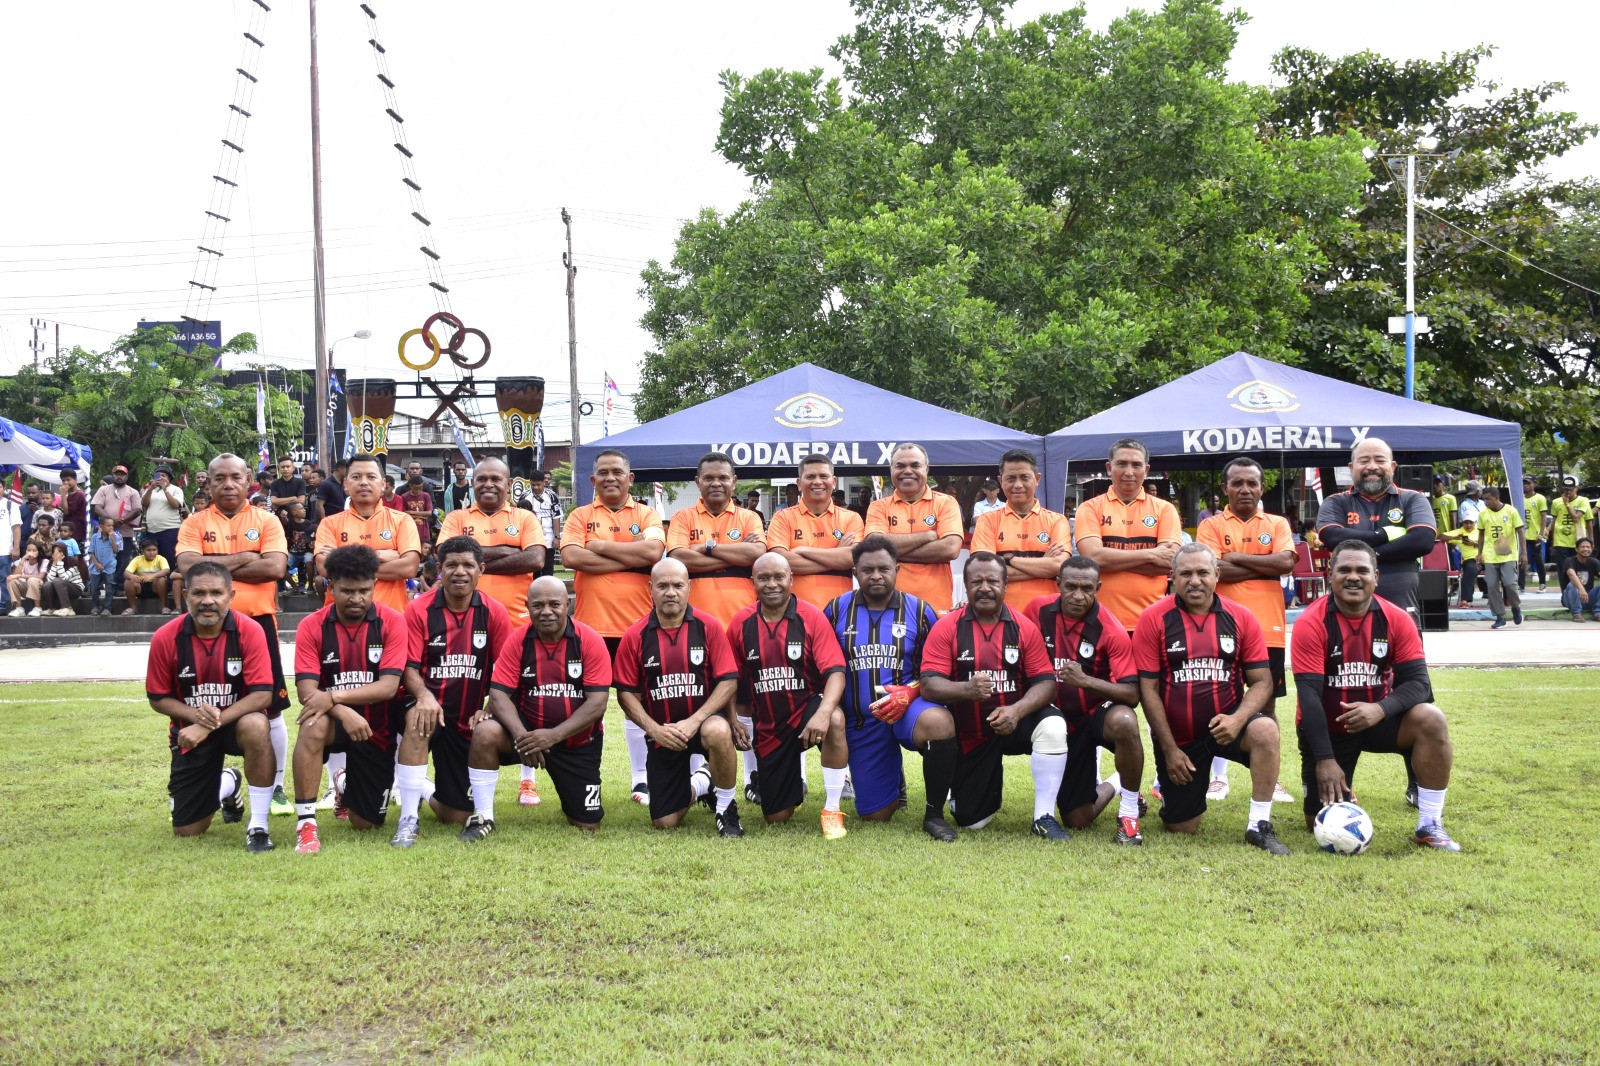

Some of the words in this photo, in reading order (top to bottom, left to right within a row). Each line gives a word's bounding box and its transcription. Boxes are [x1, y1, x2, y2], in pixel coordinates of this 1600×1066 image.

[205, 332, 217, 340] 5G
[1182, 426, 1341, 453] KODAERAL
[1350, 427, 1370, 449] X
[876, 442, 897, 465] X
[1347, 511, 1360, 525] 23
[203, 531, 217, 543] 46
[340, 532, 349, 543] 8
[794, 529, 803, 540] 12
[998, 532, 1005, 542] 4
[1224, 535, 1232, 546] 6
[853, 644, 897, 657] LEGEND
[440, 654, 477, 667] LEGEND
[848, 656, 905, 672] PERSIPURA
[1182, 658, 1224, 670] LEGEND
[430, 666, 483, 681] PERSIPURA
[758, 667, 795, 681] LEGEND
[1173, 668, 1231, 683] PERSIPURA
[1337, 662, 1379, 676] LEGEND
[333, 670, 374, 685] LEGEND
[656, 673, 696, 688] LEGEND
[1328, 674, 1382, 687] PERSIPURA
[191, 683, 233, 697] LEGEND
[650, 685, 704, 701] PERSIPURA
[754, 679, 805, 694] PERSIPURA
